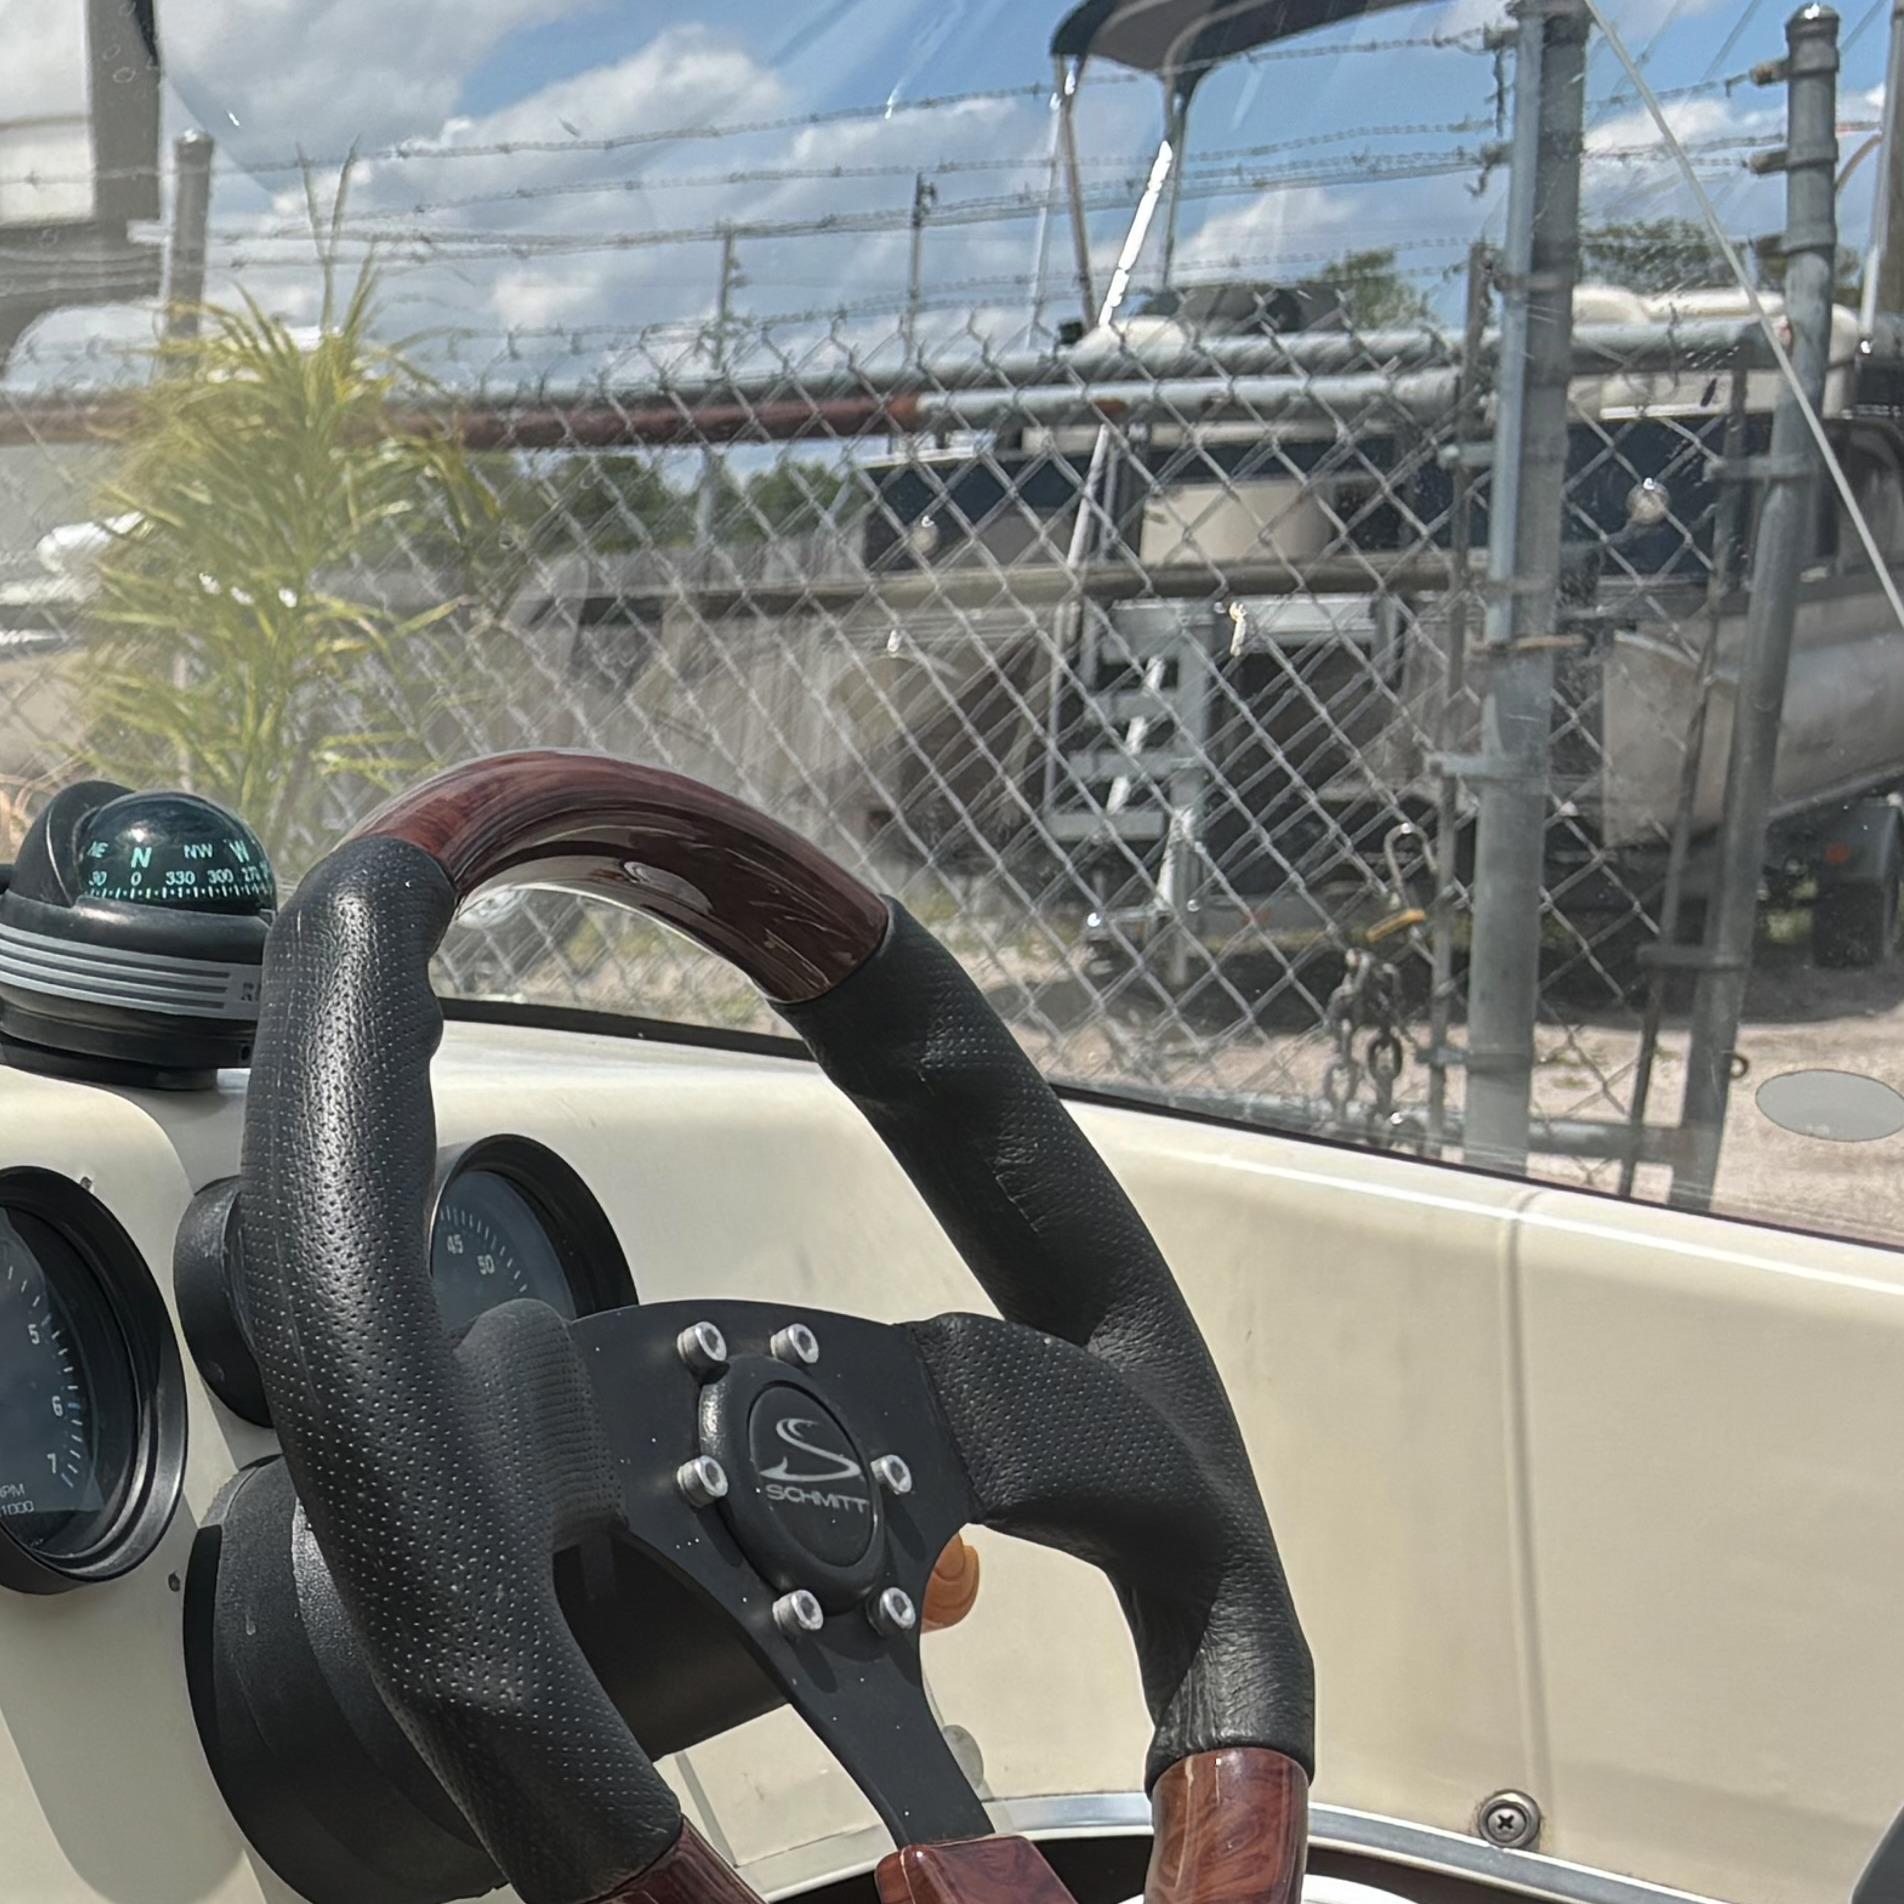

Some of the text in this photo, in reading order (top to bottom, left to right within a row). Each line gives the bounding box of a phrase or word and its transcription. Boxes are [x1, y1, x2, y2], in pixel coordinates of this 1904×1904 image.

[130, 846, 153, 869] N
[183, 843, 214, 859] NW
[229, 839, 250, 863] W
[130, 871, 142, 886] 0
[165, 870, 196, 886] 330
[207, 868, 235, 884] 300
[447, 1233, 464, 1255] 45
[476, 1253, 495, 1275] 50
[27, 1323, 41, 1345] 5
[51, 1395, 64, 1418] 6
[46, 1452, 57, 1474] 7
[765, 1483, 870, 1513] SCHMITT
